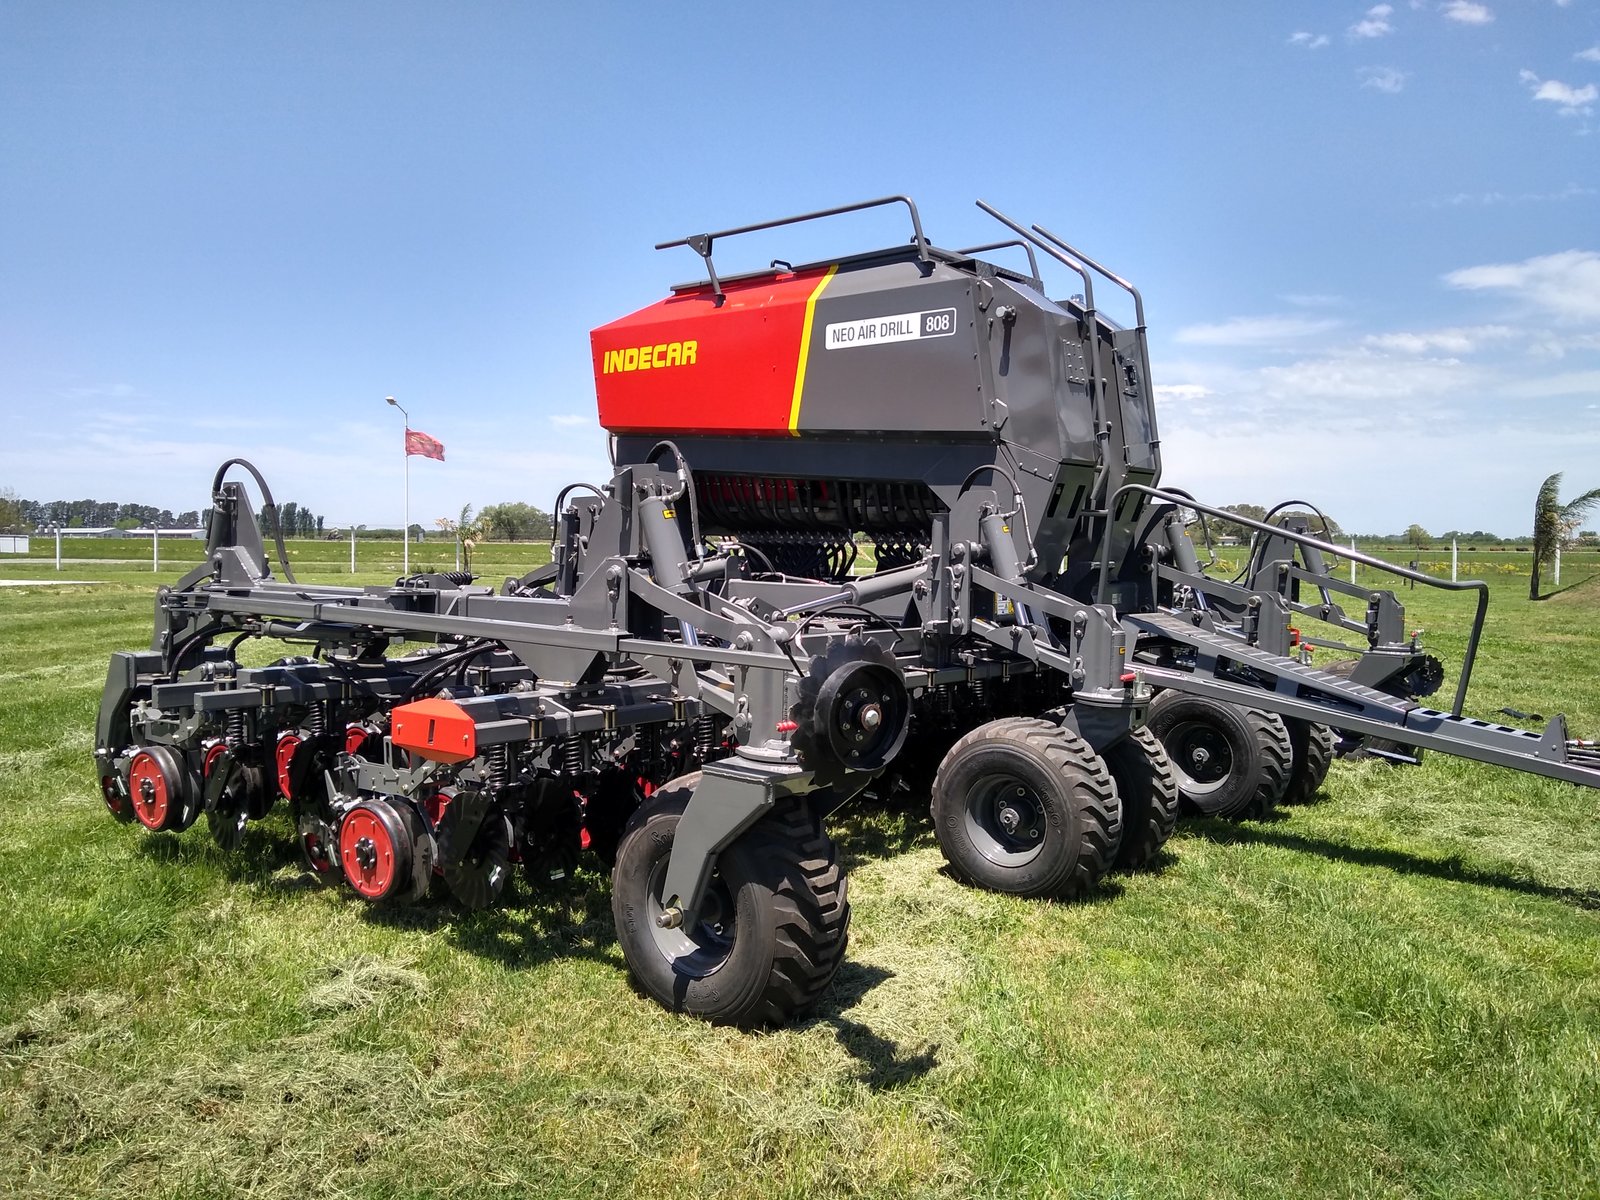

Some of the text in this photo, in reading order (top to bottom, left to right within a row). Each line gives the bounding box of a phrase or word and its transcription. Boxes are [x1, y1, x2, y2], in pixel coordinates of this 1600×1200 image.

[832, 314, 950, 343] NEO AIR DRILL 808
[603, 340, 698, 374] INDECAR
